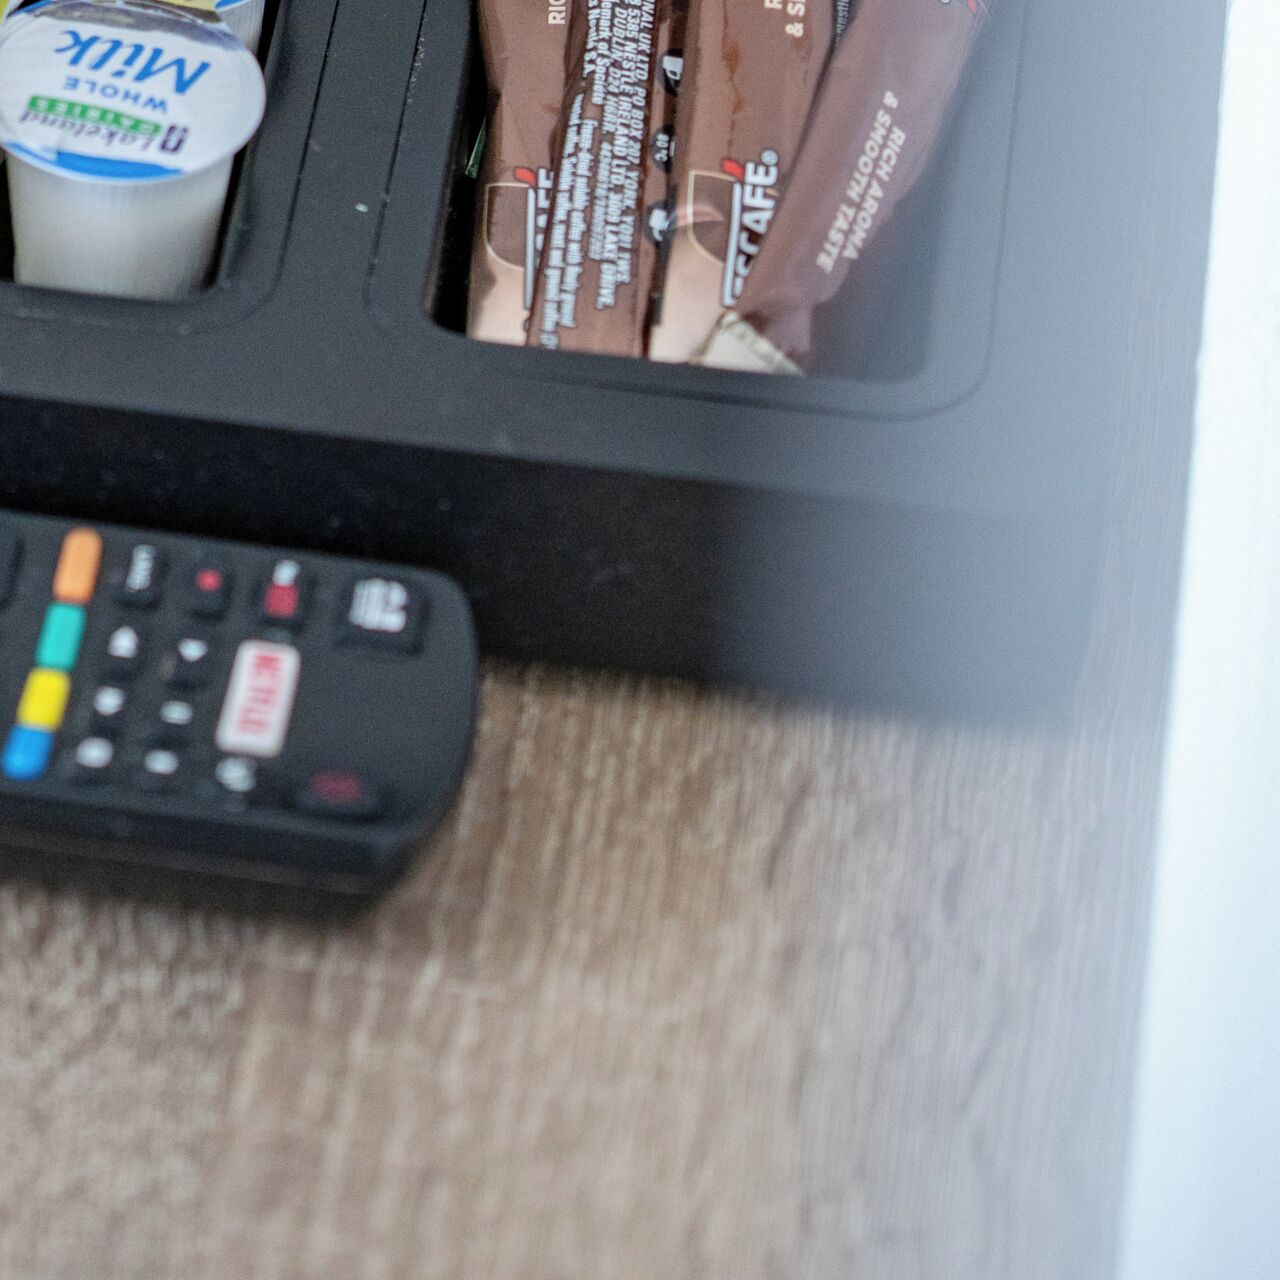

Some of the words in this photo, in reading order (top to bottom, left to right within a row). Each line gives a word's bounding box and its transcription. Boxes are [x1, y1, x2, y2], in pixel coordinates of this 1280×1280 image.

[625, 7, 641, 38] 5385
[785, 21, 805, 38] &
[598, 41, 611, 55] of
[637, 32, 652, 54] UK
[54, 29, 211, 96] Milk
[63, 75, 168, 113] WHOLE
[883, 91, 899, 109] &
[18, 109, 154, 153] Lakeland
[613, 95, 632, 157] IRELAND
[628, 109, 644, 141] BOX
[846, 109, 892, 203] SMOOTH
[876, 125, 907, 182] RICH
[841, 180, 884, 259] AROMA
[603, 225, 620, 260] LAKE
[816, 204, 857, 274] TASTE
